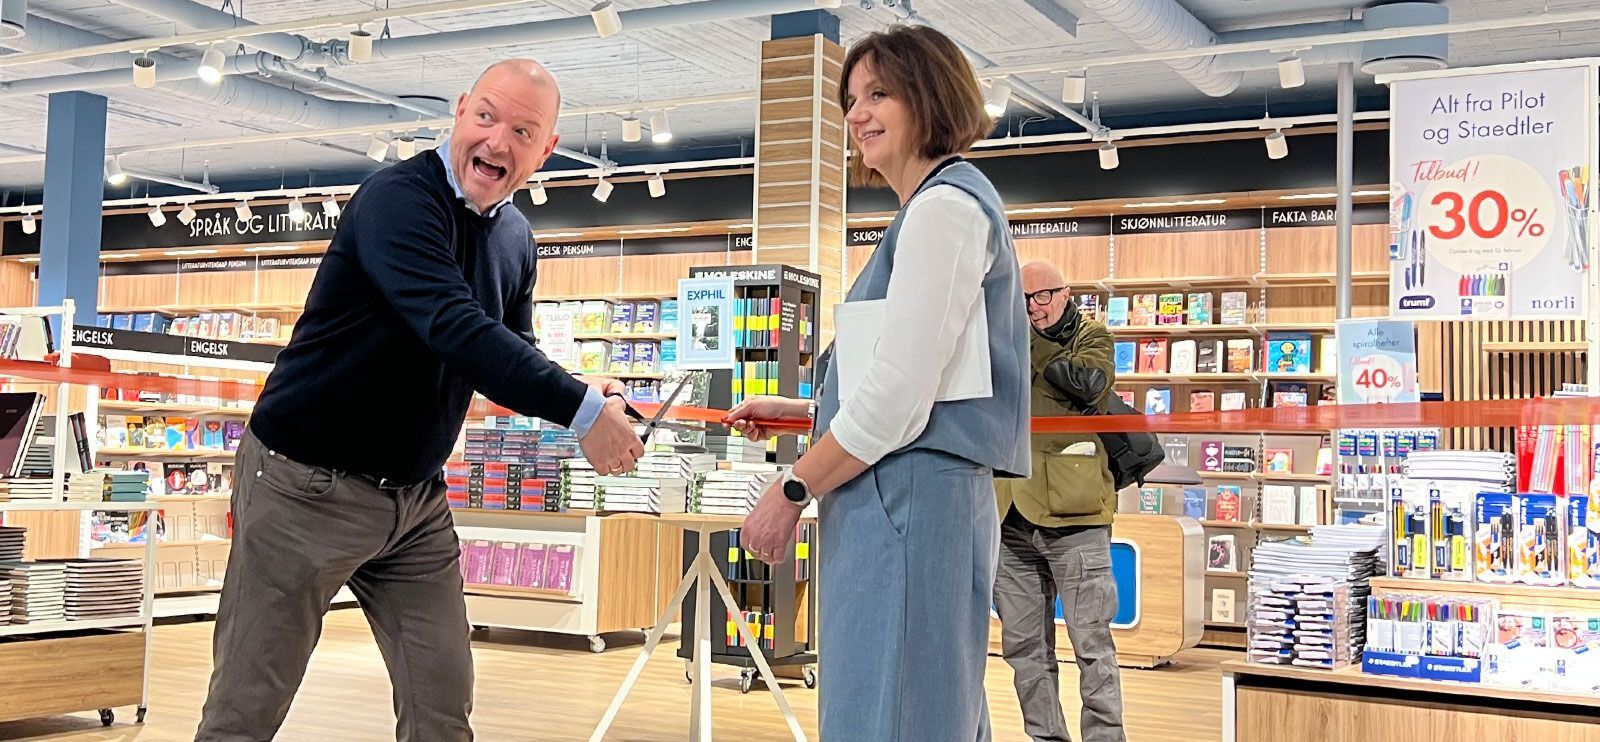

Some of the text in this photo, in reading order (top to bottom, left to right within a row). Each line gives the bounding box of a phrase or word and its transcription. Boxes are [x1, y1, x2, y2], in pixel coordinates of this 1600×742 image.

[1431, 90, 1545, 114] Alt fra Pilot
[1423, 116, 1554, 144] og Staedtler
[189, 212, 231, 237] SPRÅK
[235, 214, 264, 235] OG
[1120, 214, 1227, 231] SKJØNNLITTERATUR
[1272, 211, 1307, 224] FAKTA
[562, 245, 594, 255] PENSUM
[788, 272, 820, 288] MOLESKINE
[687, 290, 725, 300] EXPHIL
[1402, 298, 1431, 307] trumf
[1531, 296, 1576, 309] norli
[72, 329, 113, 345] ENGELSK
[1367, 328, 1385, 336] Alle
[191, 341, 228, 356] ENGELSK
[1352, 338, 1400, 349] spiralhefter
[1356, 368, 1401, 389] 40%
